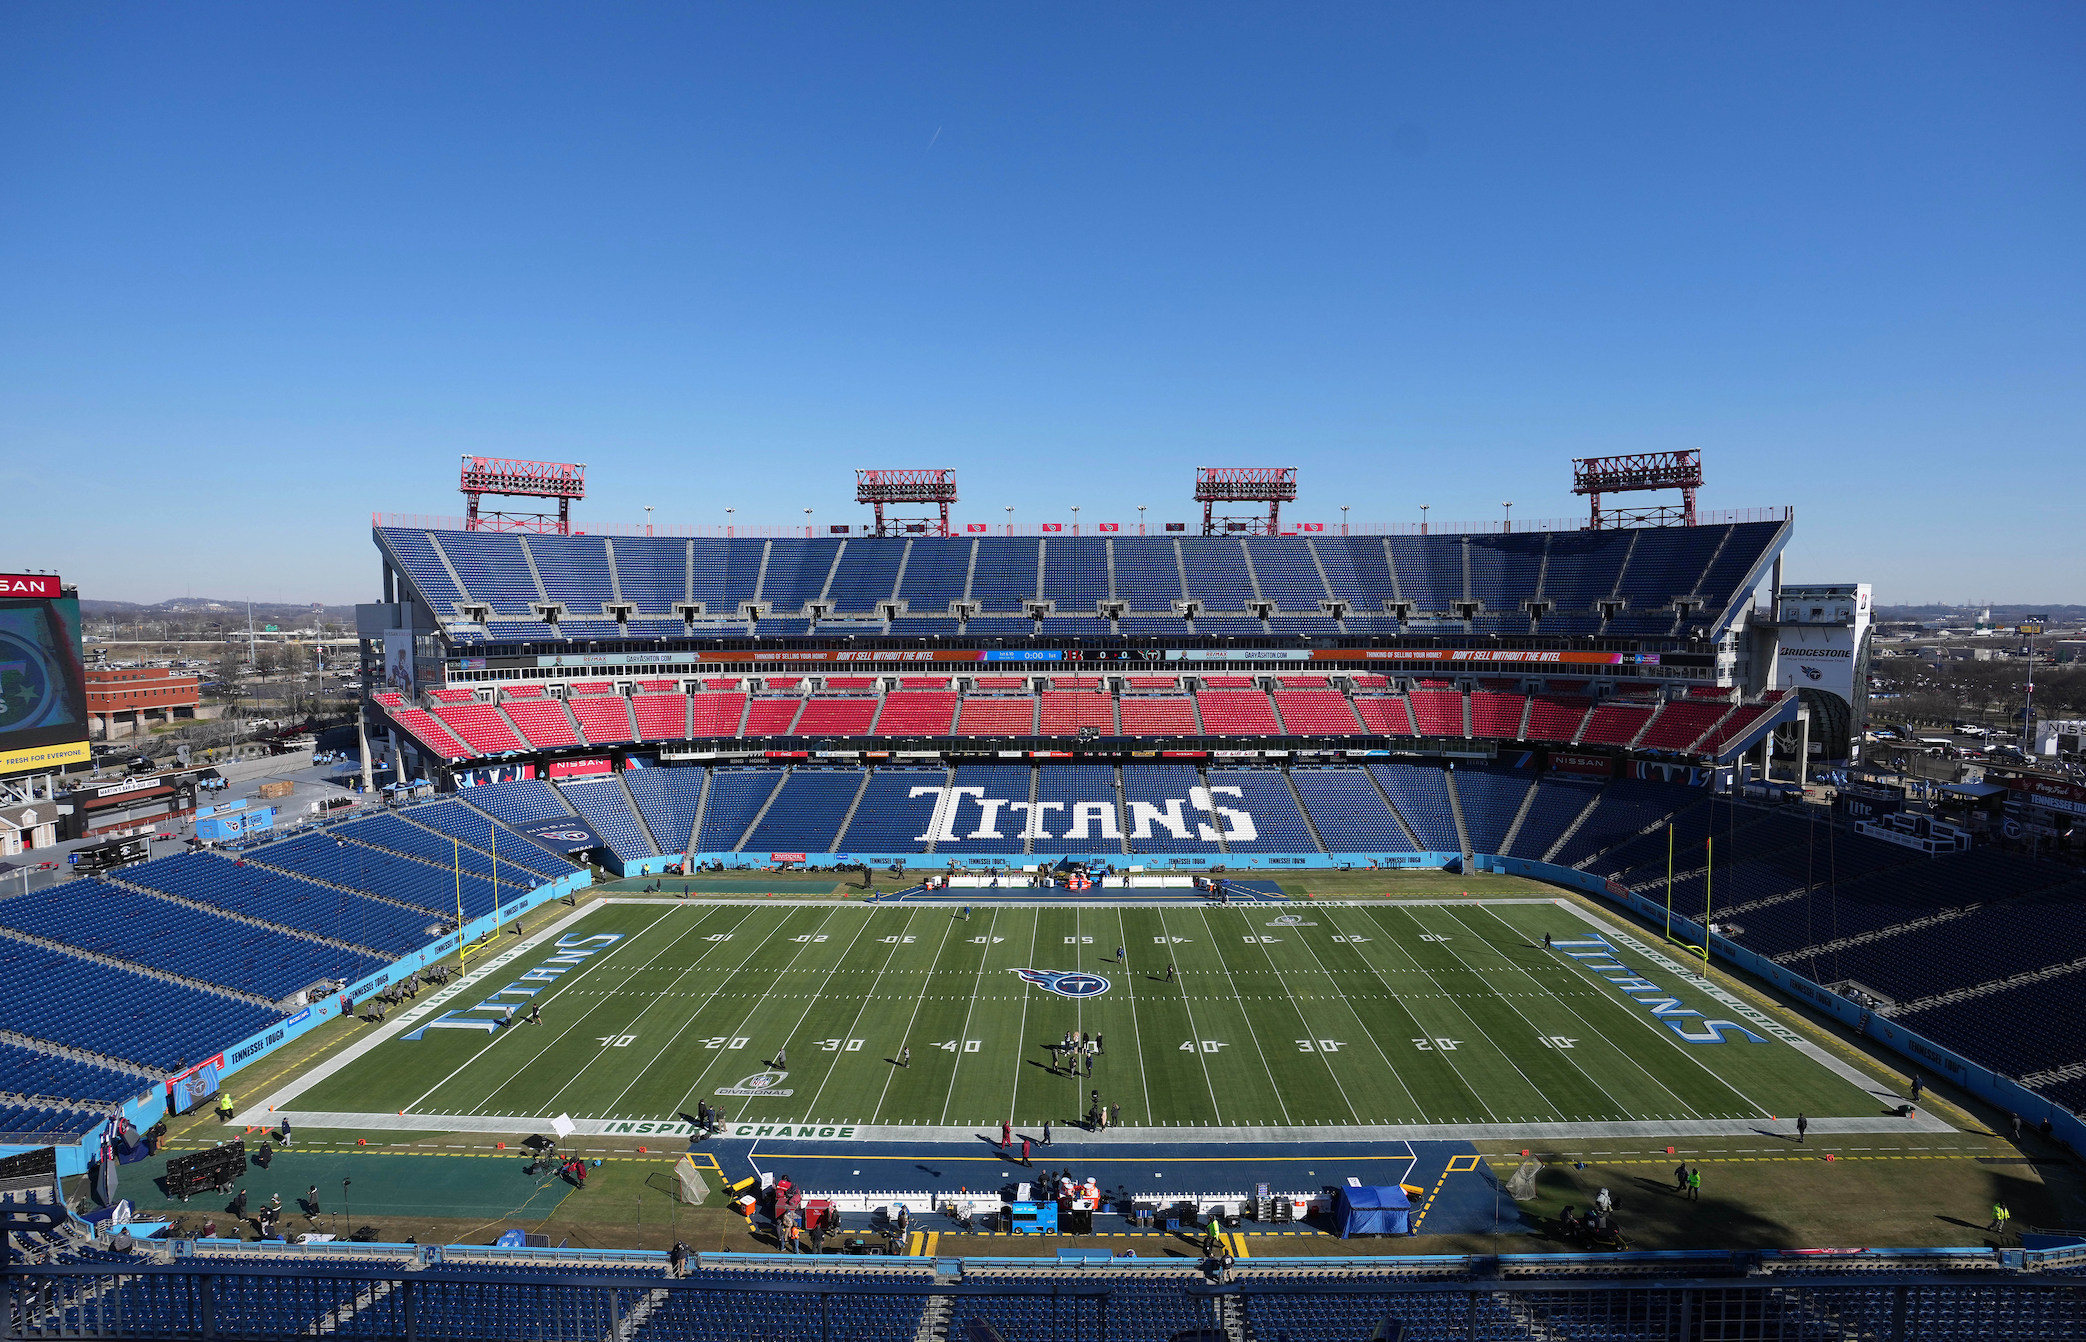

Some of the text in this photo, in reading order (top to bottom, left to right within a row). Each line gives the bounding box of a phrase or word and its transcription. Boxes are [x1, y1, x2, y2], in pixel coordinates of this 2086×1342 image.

[836, 651, 934, 660] DON'T SELL WITHOUT THE INTEL
[1099, 651, 1106, 659] 0
[1121, 651, 1128, 659] 0
[1452, 651, 1561, 661] DON'T SELL WITHOUT THE INTEL
[1780, 647, 1852, 658] BRIDGESTONE
[6, 750, 81, 765] FRESH FOR EVERYONE
[557, 759, 603, 768] NISSAN
[1555, 756, 1604, 767] NISSAN
[99, 786, 121, 795] MARTIN'S
[146, 780, 158, 788] JOINT
[1849, 800, 1872, 815] Lite
[2031, 794, 2073, 810] TENNESSEE
[908, 786, 1258, 842] TITANS
[568, 844, 593, 853] NISSAN
[434, 939, 453, 955] TENNESSEE
[350, 973, 389, 1000] TENNESSEE TOUGH
[398, 942, 535, 1022] IT TAKES ALL OF US
[400, 932, 626, 1040] TITANS
[1540, 933, 1771, 1044] TITANS
[1612, 933, 1804, 1044] ADVANCE SOCIAL JUSTICE
[1789, 978, 1832, 1008] TENNESSEE TOUGH
[231, 1028, 284, 1066] TENNESSEE TOUGH
[599, 1035, 637, 1047] 10
[704, 1036, 751, 1050] 20
[820, 1038, 866, 1051] 30
[941, 1039, 983, 1053] 40
[1179, 1040, 1220, 1053] 40
[1294, 1039, 1339, 1052] 30
[1411, 1038, 1456, 1051] 20
[1538, 1036, 1573, 1049] 10
[1908, 1039, 1942, 1066] TENNESSEE
[735, 1125, 856, 1138] CHANGE
